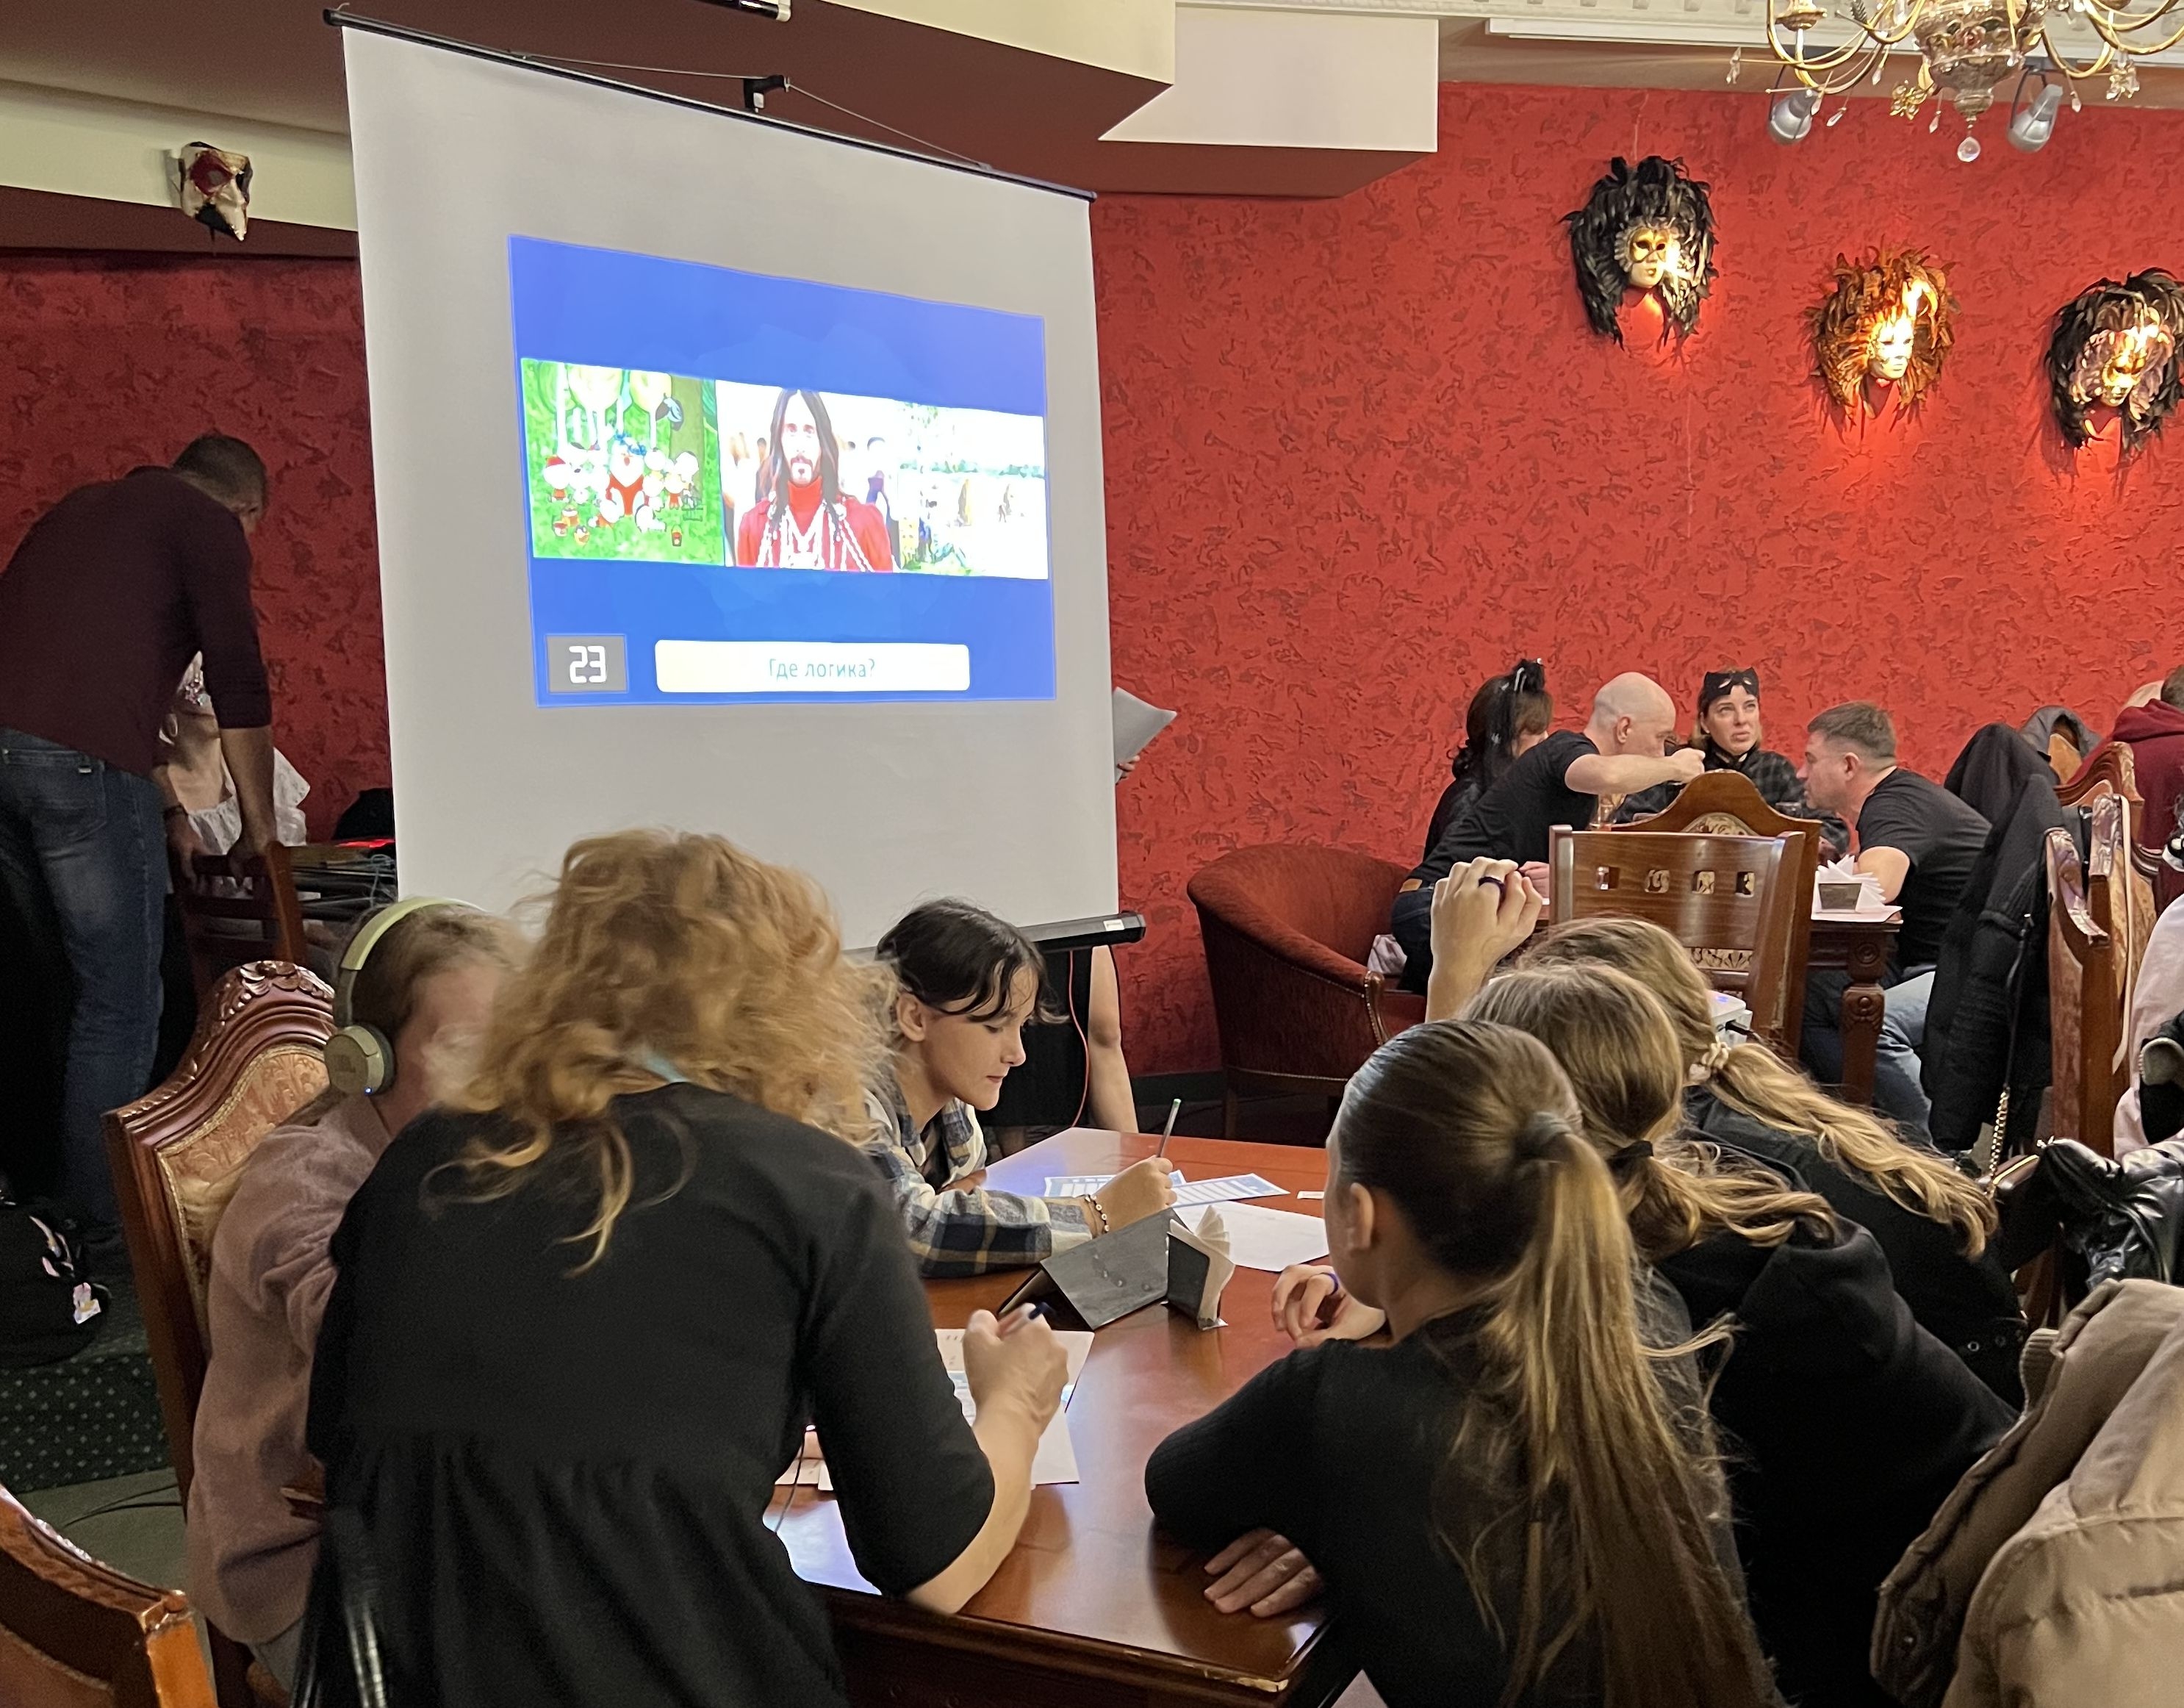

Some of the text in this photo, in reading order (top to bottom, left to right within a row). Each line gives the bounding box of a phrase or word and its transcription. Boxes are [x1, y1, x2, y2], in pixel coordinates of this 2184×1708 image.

[569, 645, 607, 683] 23
[769, 658, 875, 683] Где логика?
